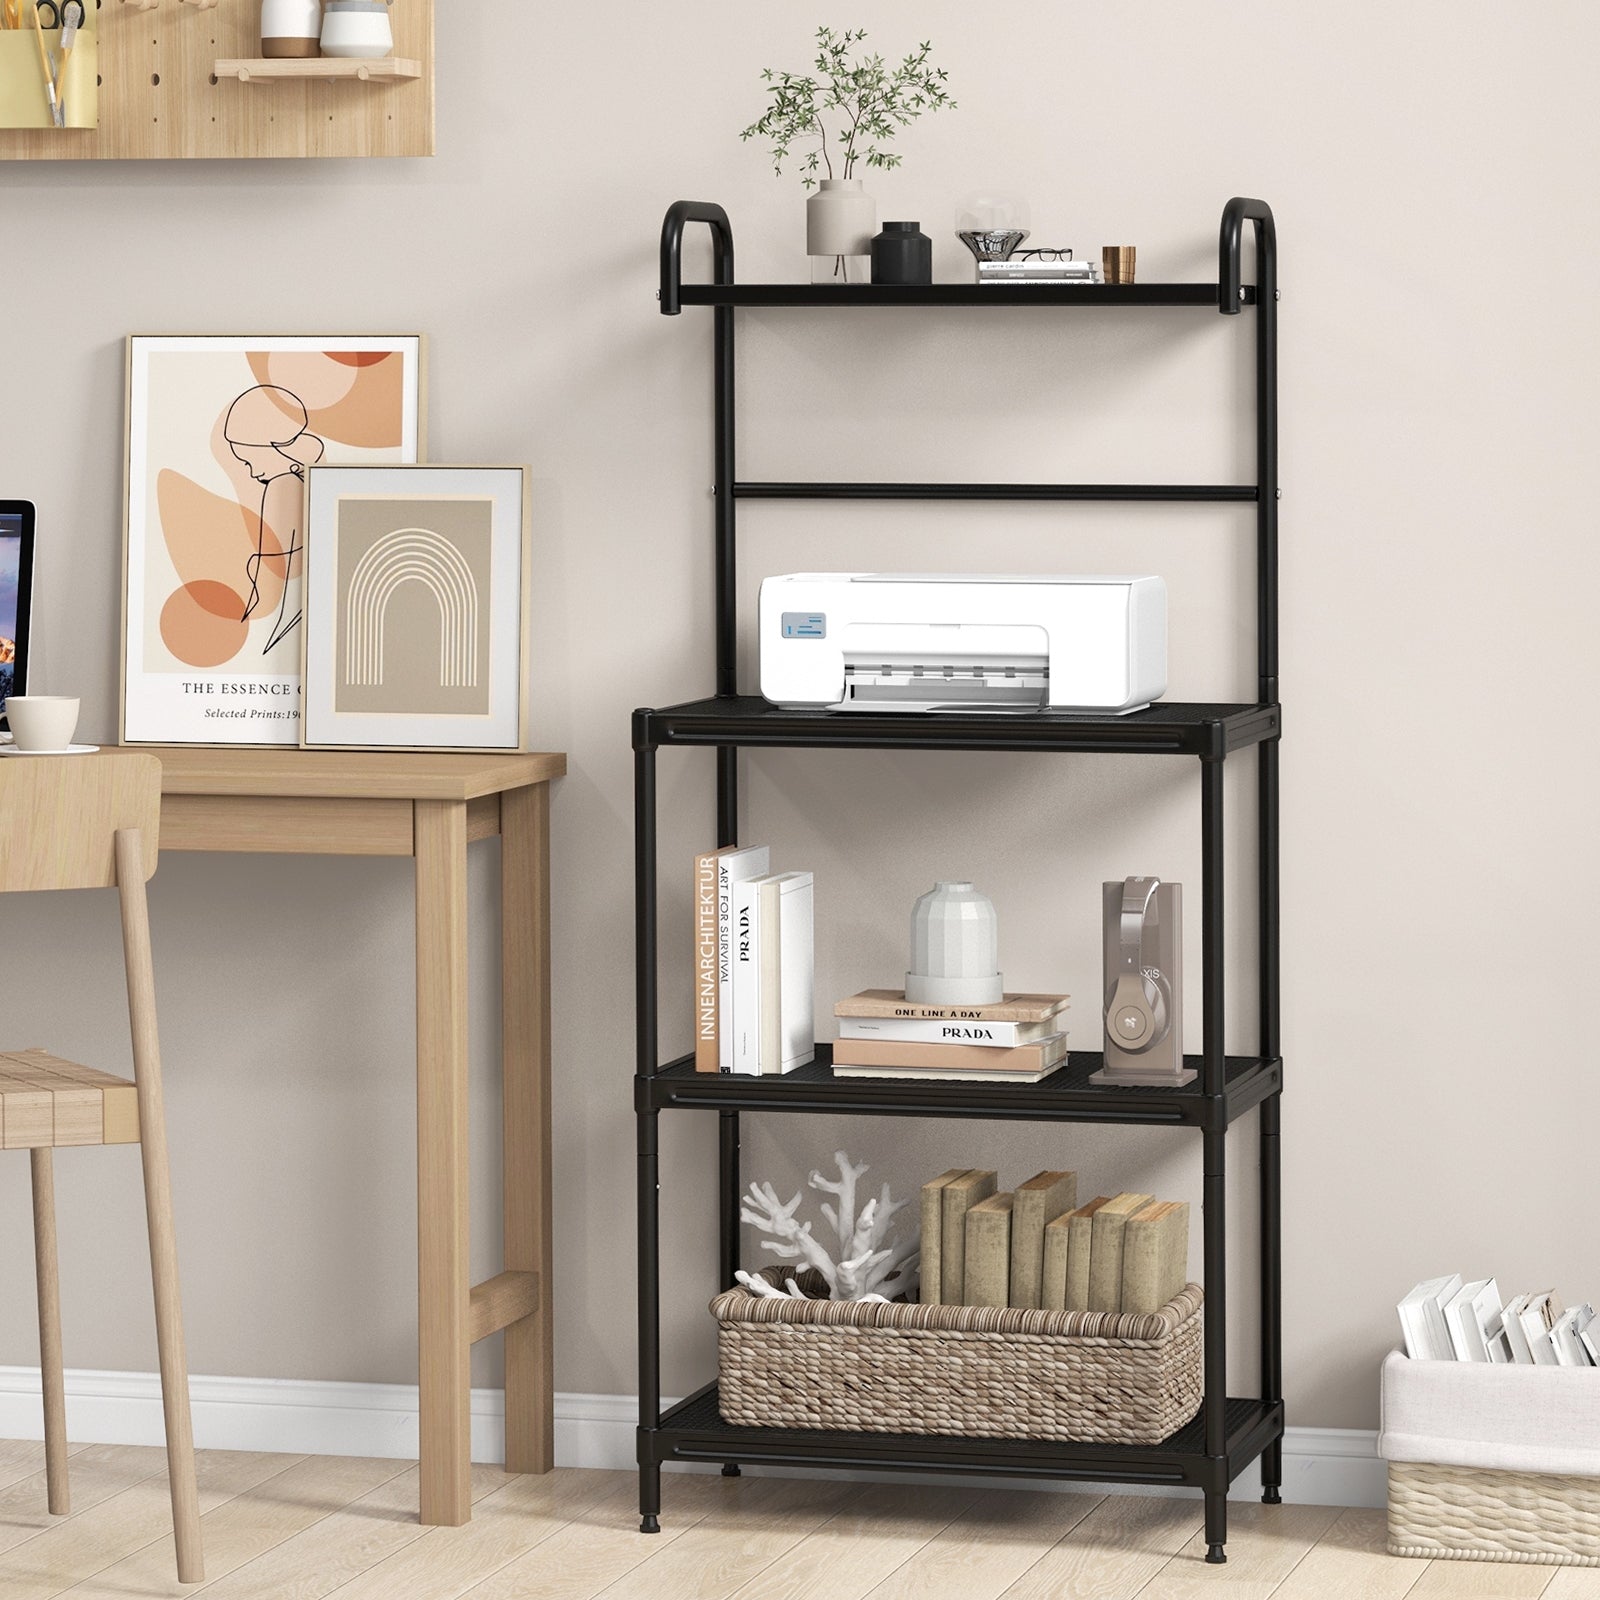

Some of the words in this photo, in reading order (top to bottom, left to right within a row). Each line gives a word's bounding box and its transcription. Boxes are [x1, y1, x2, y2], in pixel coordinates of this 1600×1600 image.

[182, 682, 215, 694] THE
[221, 683, 291, 695] ESSENCE
[204, 708, 247, 719] Selected
[720, 866, 729, 890] ART
[720, 895, 729, 922] FOR
[740, 906, 750, 962] PRADA
[700, 857, 715, 1041] INNENARCHITEKTUR
[720, 926, 729, 984] SURVIVAL
[921, 1010, 946, 1018] LINE
[950, 1010, 958, 1018] A
[942, 1027, 993, 1040] PRADA
